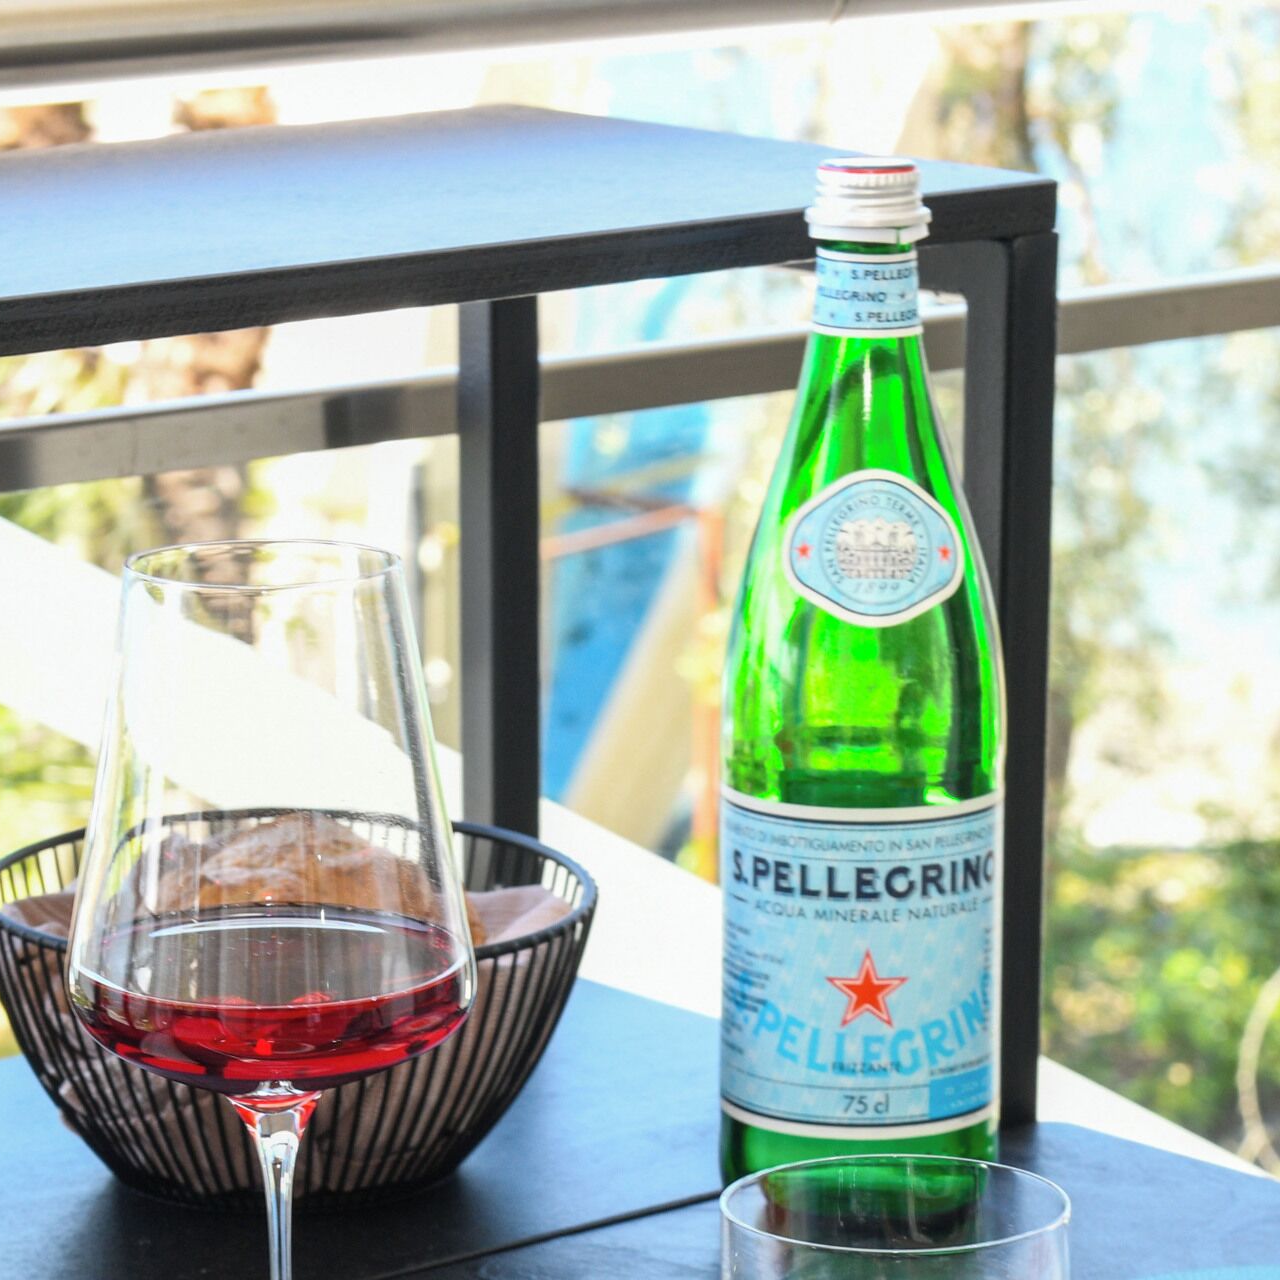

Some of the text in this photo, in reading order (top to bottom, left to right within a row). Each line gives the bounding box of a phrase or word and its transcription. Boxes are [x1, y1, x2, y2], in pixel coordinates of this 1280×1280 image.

[905, 837, 932, 851] SAN
[755, 897, 979, 923] ACQUA MINERALE NATURALE
[831, 1060, 901, 1074] FRIZZANTE
[842, 1092, 890, 1115] 75 cl
